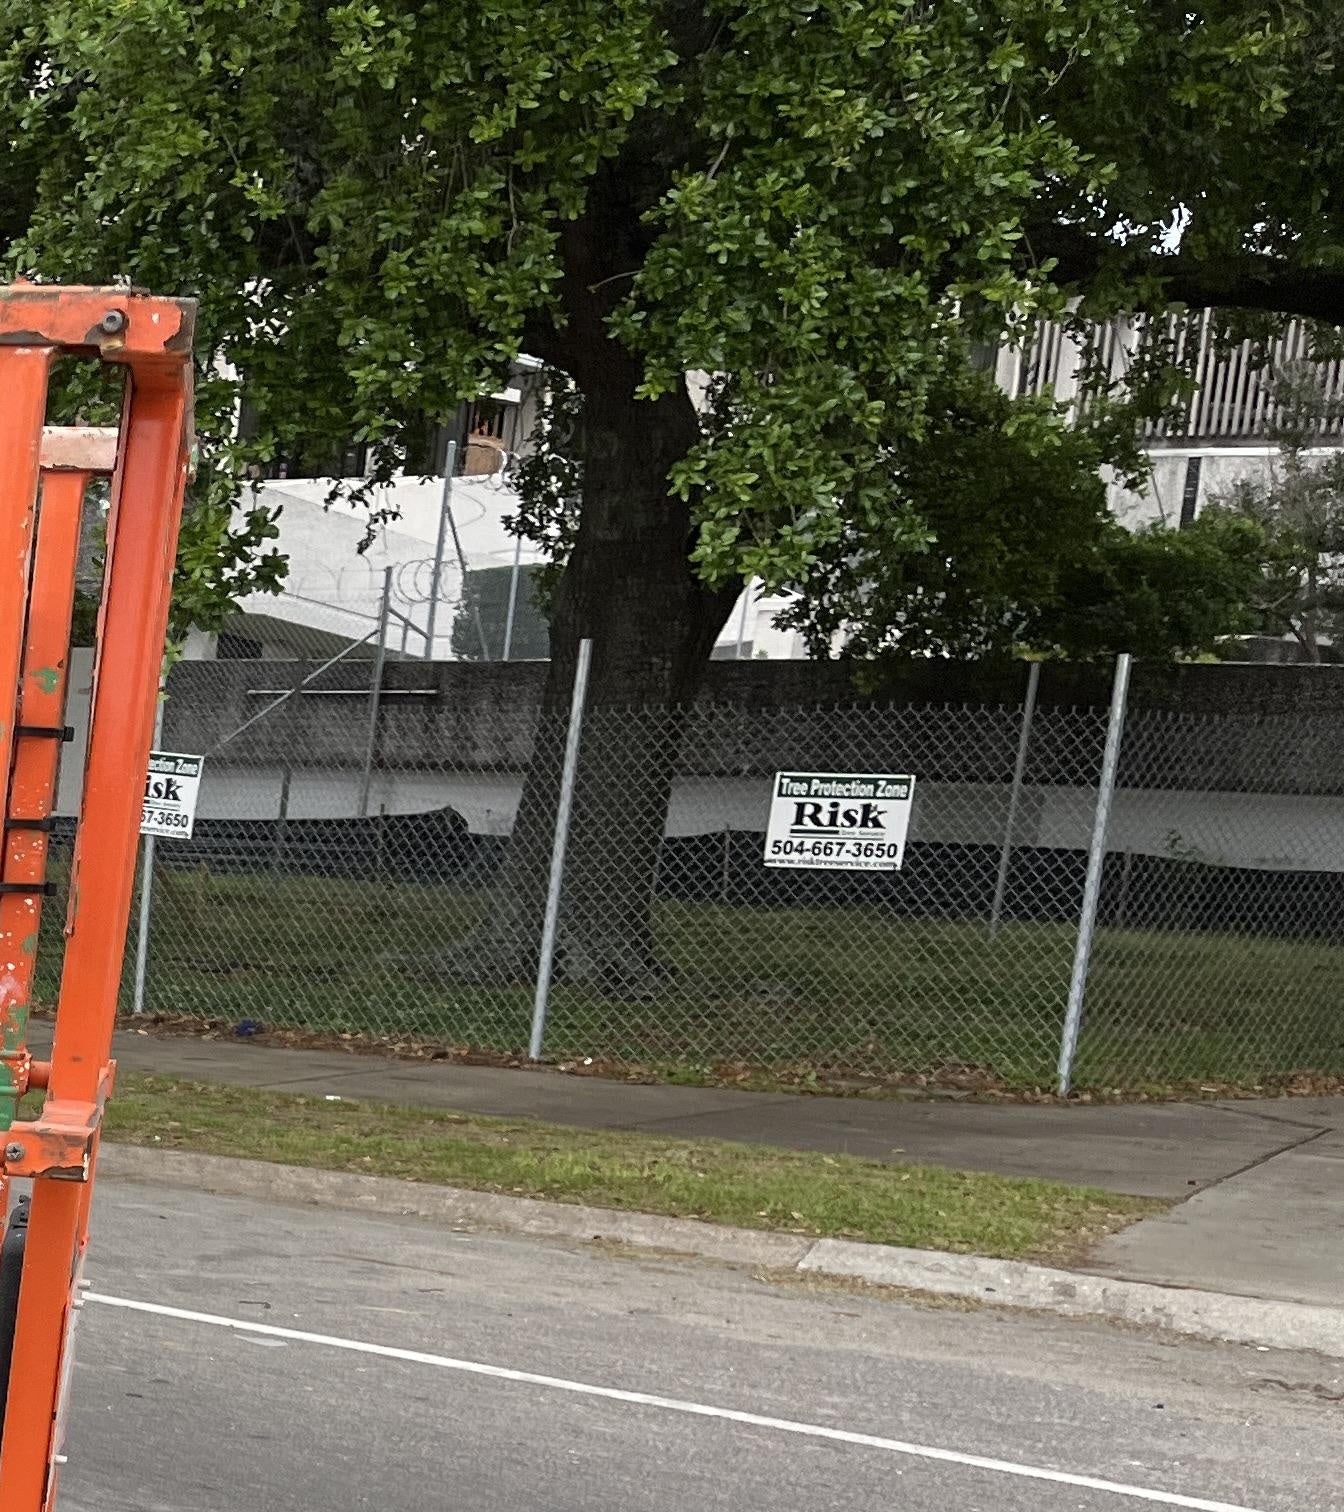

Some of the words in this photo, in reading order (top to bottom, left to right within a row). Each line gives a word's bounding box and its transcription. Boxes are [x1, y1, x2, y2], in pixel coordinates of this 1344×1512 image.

[144, 775, 183, 801] isk
[780, 778, 808, 796] Tree
[810, 779, 874, 797] Protection
[875, 780, 908, 798] Zone
[792, 801, 888, 829] Risk
[771, 840, 898, 858] 504-667-3650
